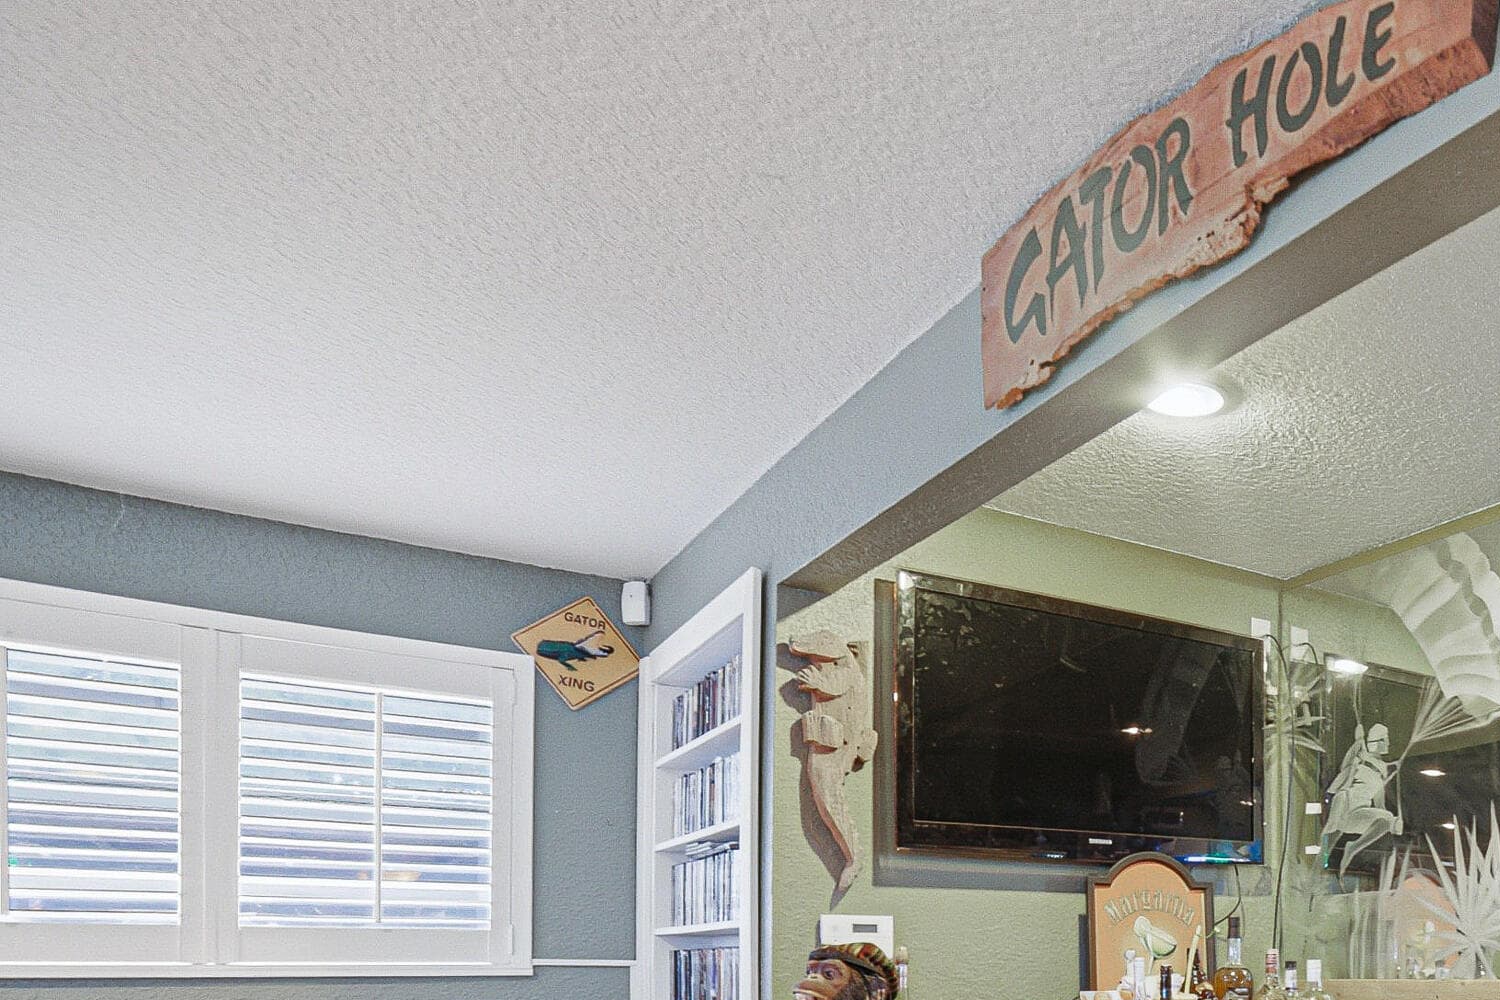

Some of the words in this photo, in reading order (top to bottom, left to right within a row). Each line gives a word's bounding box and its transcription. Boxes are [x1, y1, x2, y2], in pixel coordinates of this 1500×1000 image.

[1004, 116, 1194, 344] GATOR
[1226, 1, 1395, 168] HOLE
[564, 612, 606, 630] GATOR
[559, 675, 595, 692] XING
